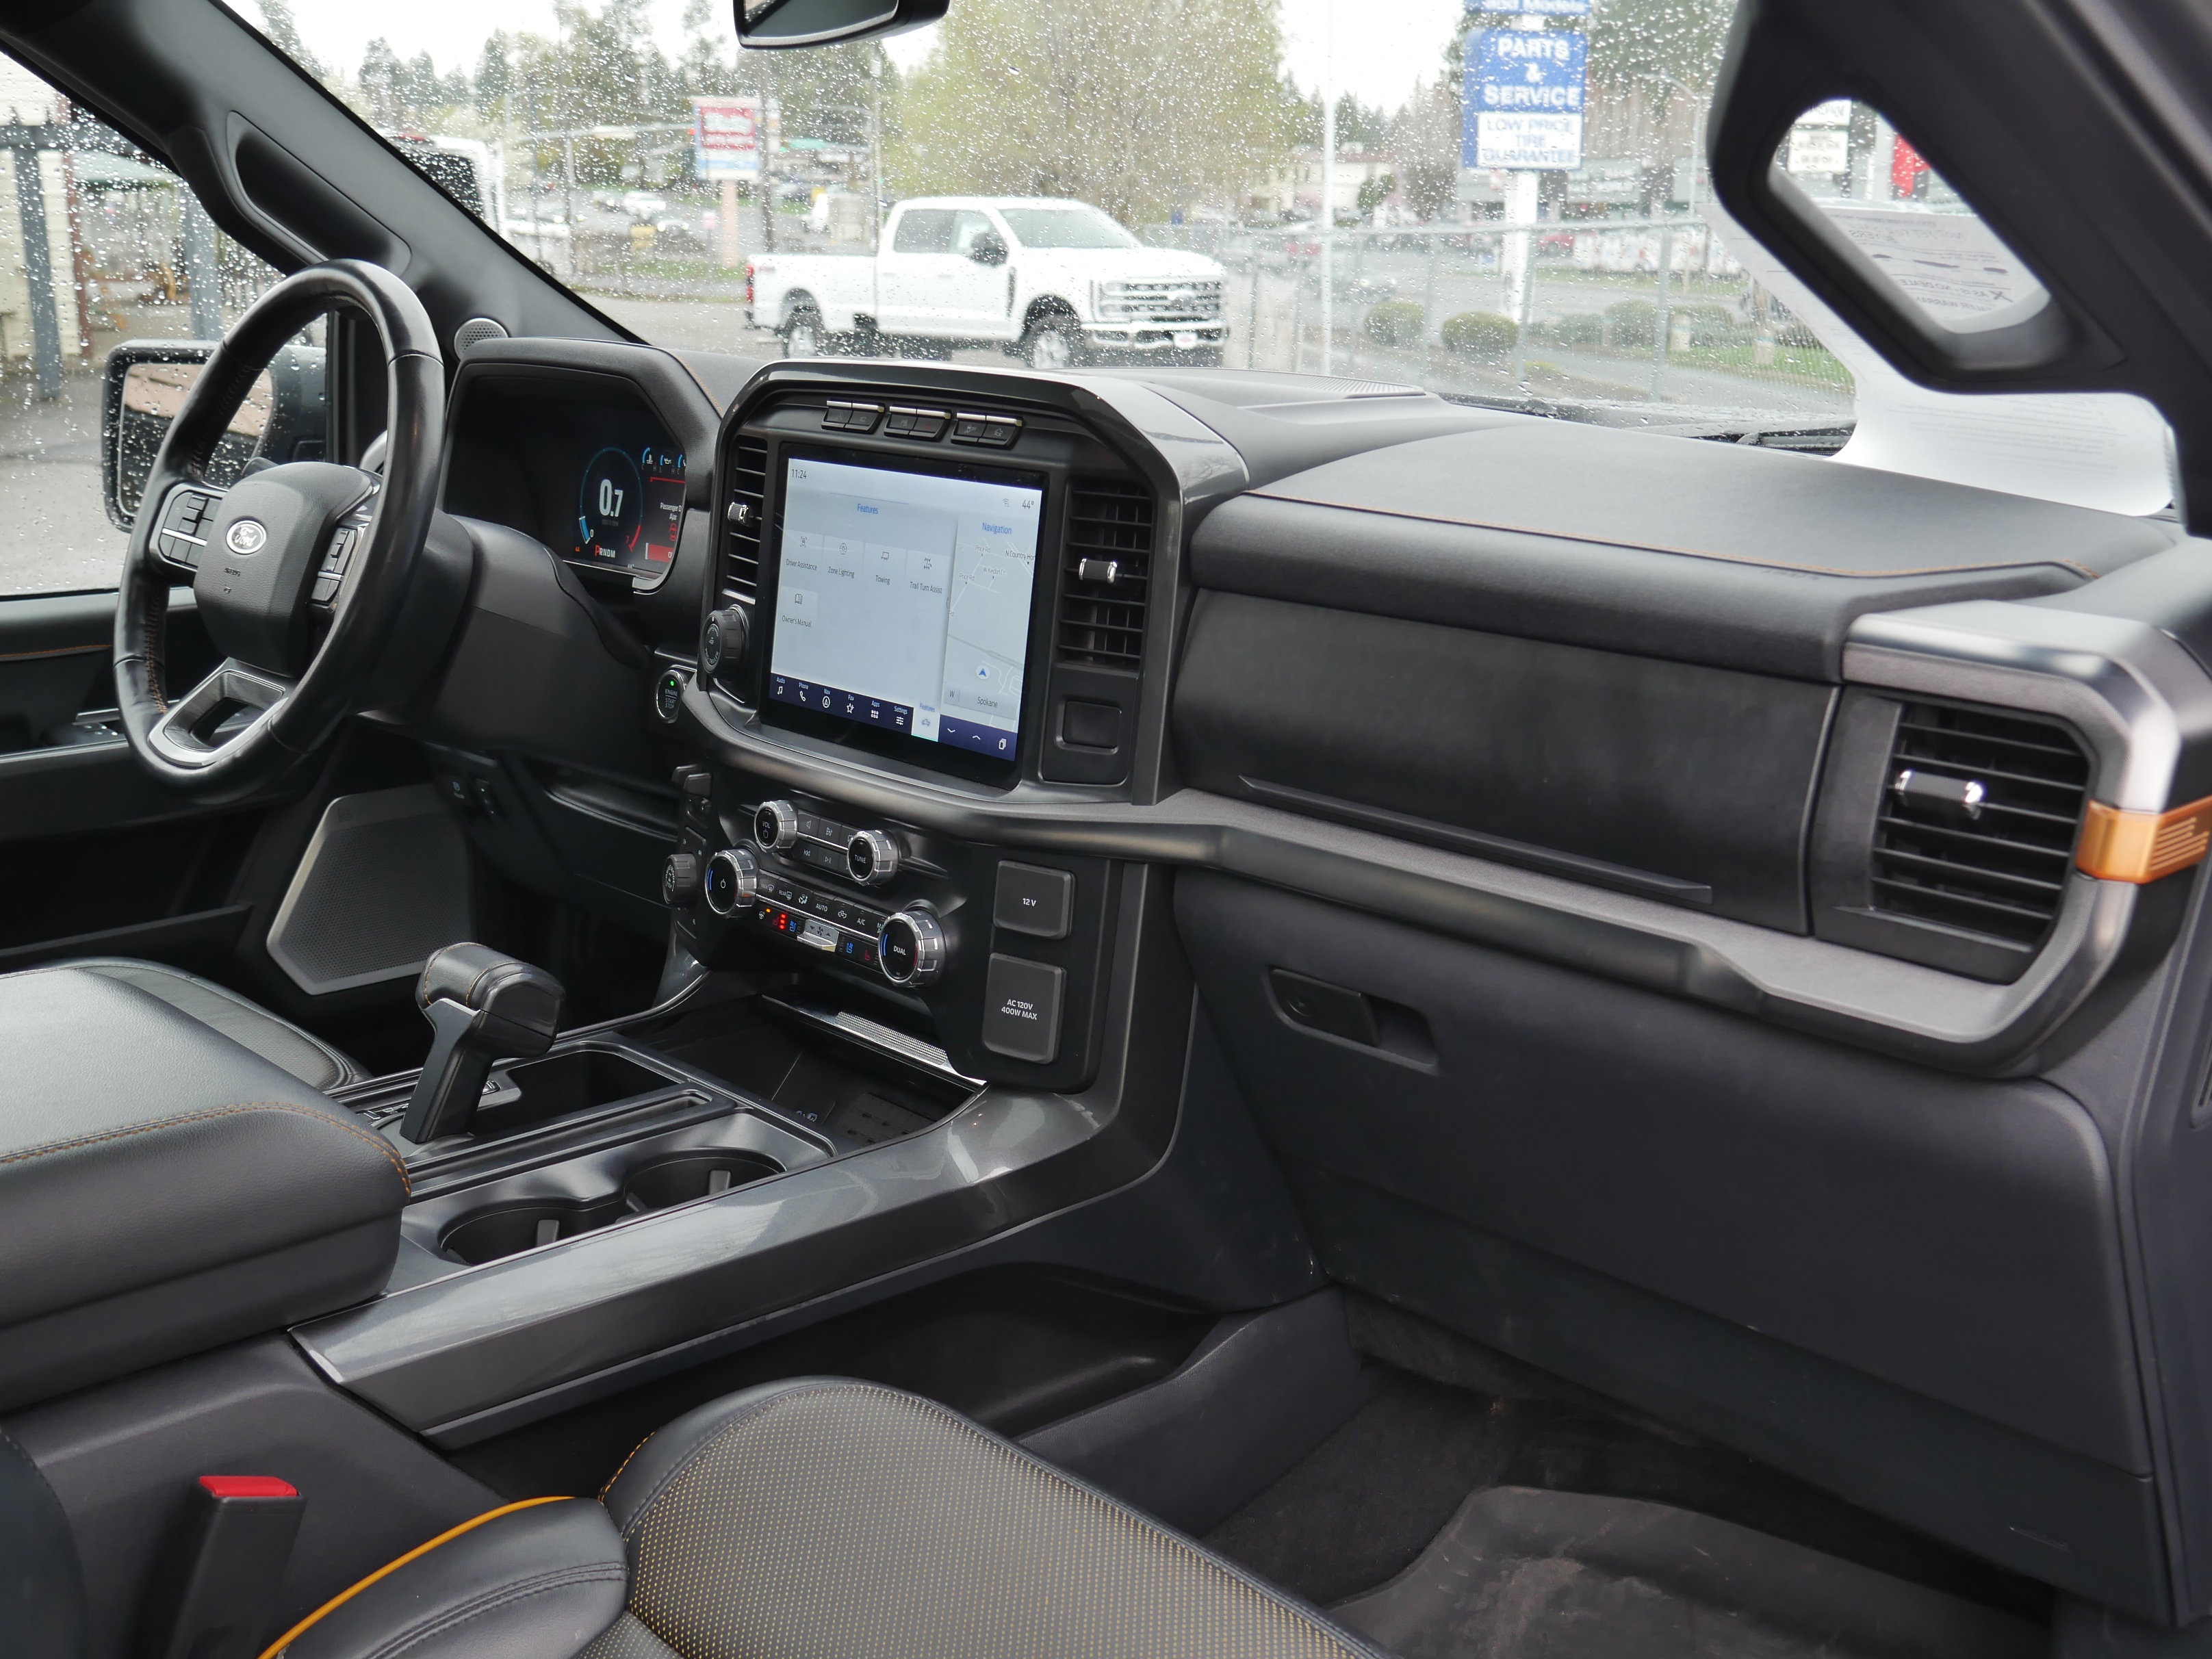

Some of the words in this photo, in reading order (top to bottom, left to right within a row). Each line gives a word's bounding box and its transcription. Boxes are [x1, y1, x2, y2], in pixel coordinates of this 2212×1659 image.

[1497, 37, 1569, 60] PARTS
[1526, 62, 1542, 83] &
[1483, 84, 1582, 107] SERVICE
[1487, 118, 1522, 131] LOW
[1528, 118, 1573, 132] PRICE
[791, 469, 807, 479] 11:24
[599, 479, 623, 517] 0.7
[660, 502, 678, 512] Passenger
[857, 503, 879, 514] Features
[1022, 500, 1034, 509] 44°
[669, 513, 677, 521] Ajar
[981, 522, 1012, 535] Navigation
[234, 526, 257, 548] Ford
[1009, 550, 1027, 561] Country
[786, 558, 797, 567] Driver
[797, 561, 817, 571] Assistance
[828, 567, 838, 575] Zone
[838, 568, 855, 578] Lighting
[875, 575, 890, 585] Towing
[910, 581, 918, 589] Trail
[920, 583, 929, 591] Turn
[930, 585, 942, 594] Assist
[782, 615, 797, 624] Owner's
[797, 618, 811, 627] Manual
[665, 689, 678, 697] ENGINE
[919, 703, 936, 712] Features
[977, 696, 998, 708] Spokane
[894, 706, 908, 715] Settings
[855, 855, 866, 864] TUNE
[816, 903, 828, 912] AUTO
[893, 945, 906, 955] DUAL
[1007, 999, 1016, 1007] AC
[1017, 1001, 1033, 1010] 120V
[1001, 1006, 1021, 1016] 400W
[1022, 1011, 1038, 1020] MAX
